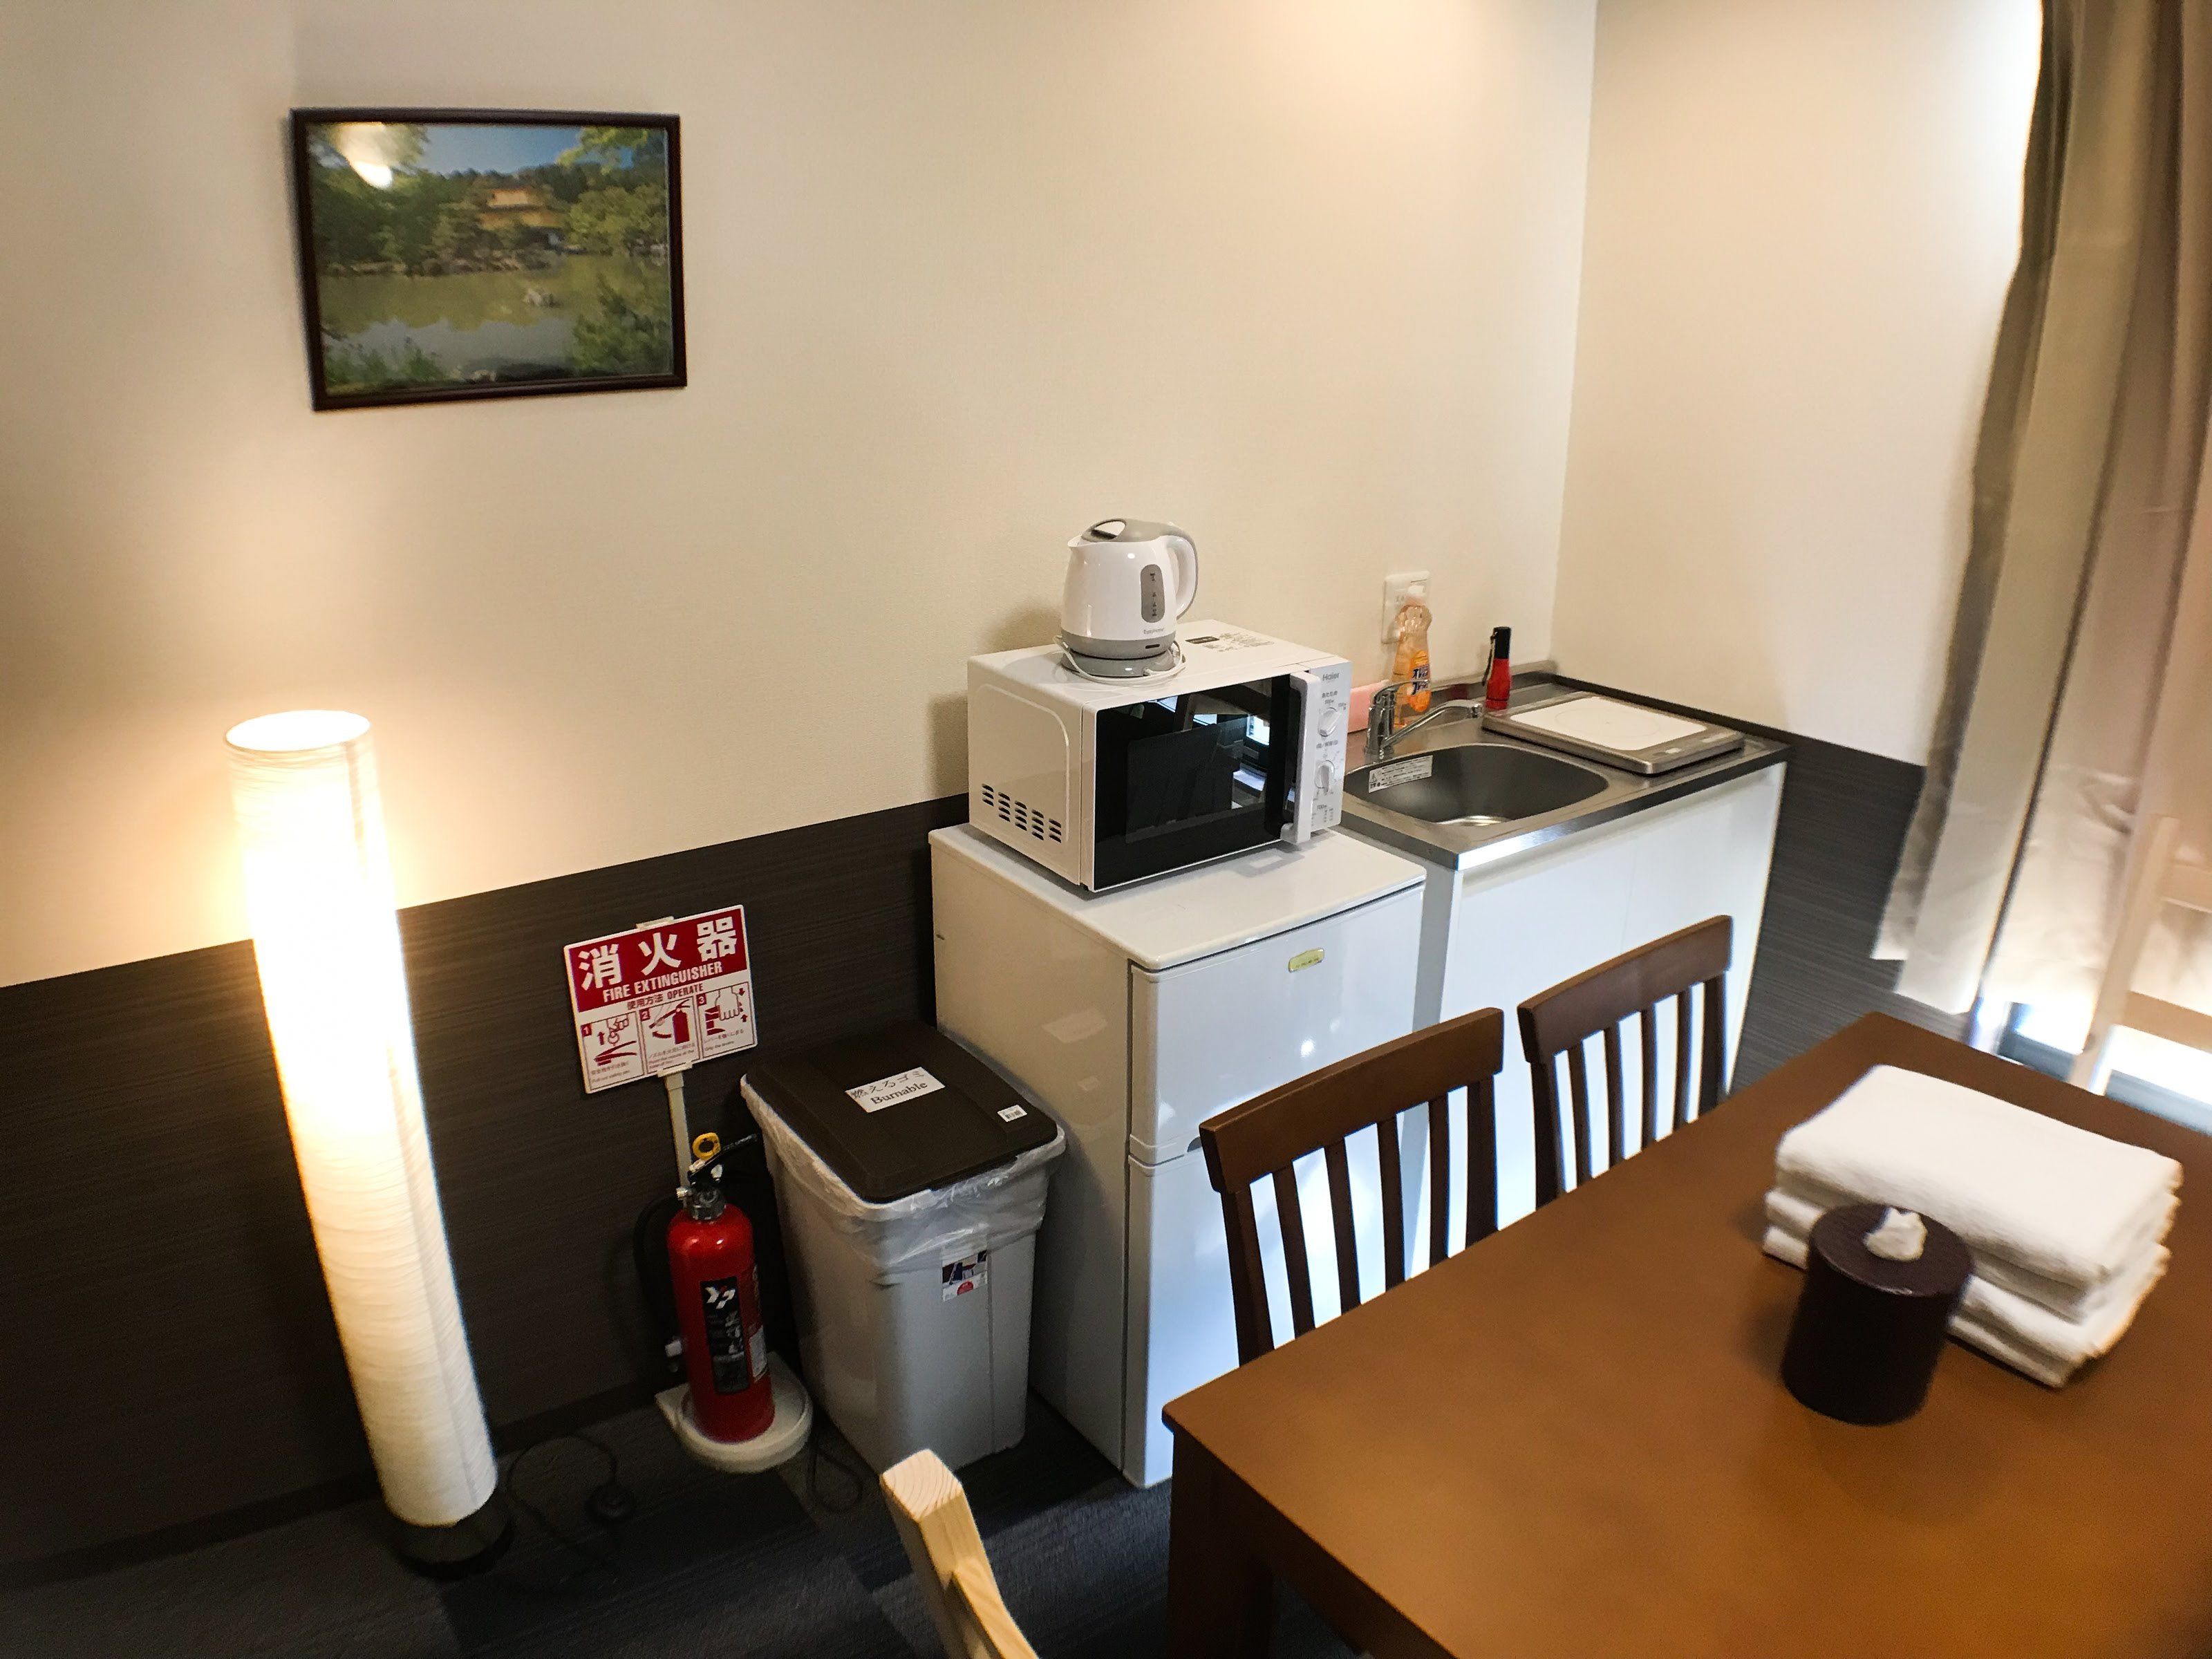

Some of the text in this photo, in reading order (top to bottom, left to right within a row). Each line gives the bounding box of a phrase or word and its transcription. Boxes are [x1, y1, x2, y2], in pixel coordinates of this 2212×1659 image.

[1322, 673, 1340, 682] Haier
[578, 916, 738, 991] 消火器
[603, 961, 723, 1003] FIRE EXTINGUISHER
[627, 983, 704, 1010] 使用方法 OPERATE
[698, 996, 704, 1004] 3
[641, 1011, 649, 1020] 2
[850, 1071, 925, 1098] 燃えるゴミ
[870, 1082, 928, 1105] Burnable
